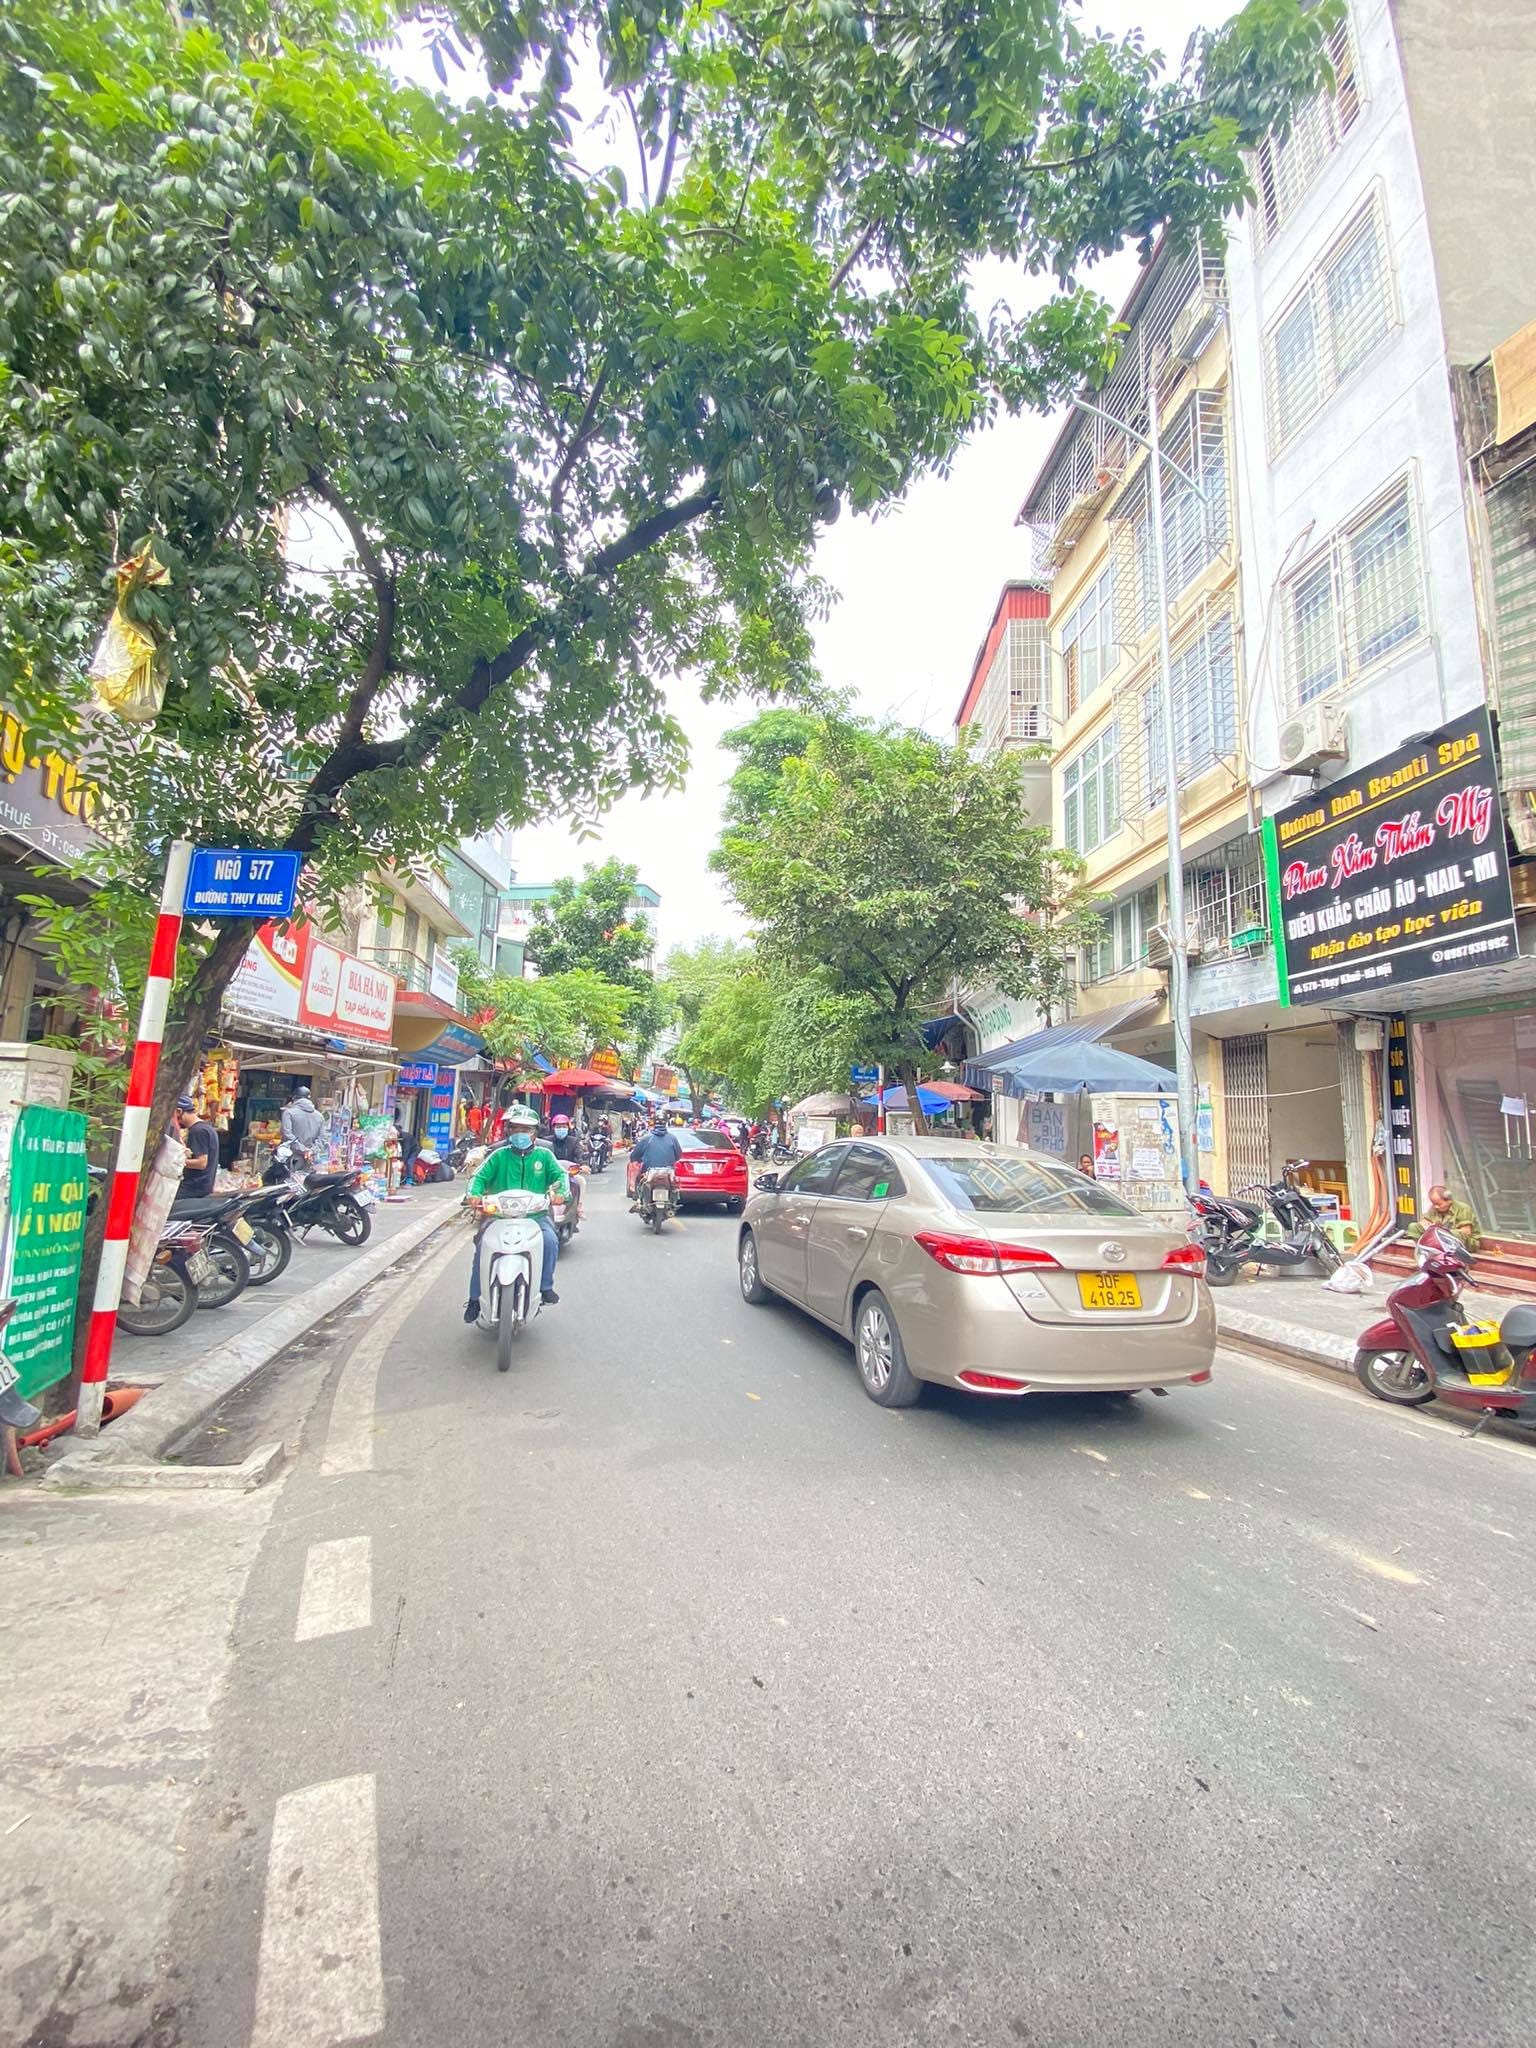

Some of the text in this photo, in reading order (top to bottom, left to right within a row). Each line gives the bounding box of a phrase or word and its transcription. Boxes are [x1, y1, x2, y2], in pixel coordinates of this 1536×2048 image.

[1367, 754, 1429, 799] Beauti
[1437, 731, 1480, 765] Spa
[1283, 861, 1328, 900] Phun
[1436, 785, 1494, 844] Mỹ
[214, 855, 274, 880] NGÕ 577
[194, 889, 284, 908] ĐƯỜNG THỤY KHUÊ
[1317, 896, 1352, 932] KHẮC
[1355, 886, 1392, 919] CHÂU
[1396, 878, 1417, 909] ÂU
[1425, 864, 1465, 897] NAIL
[1310, 898, 1483, 960] Nhận đào tạo học viên
[348, 970, 361, 994] BIA
[344, 1001, 357, 1015] TẠP
[1095, 1274, 1120, 1289] 30F
[1090, 1291, 1135, 1306] 418.25
